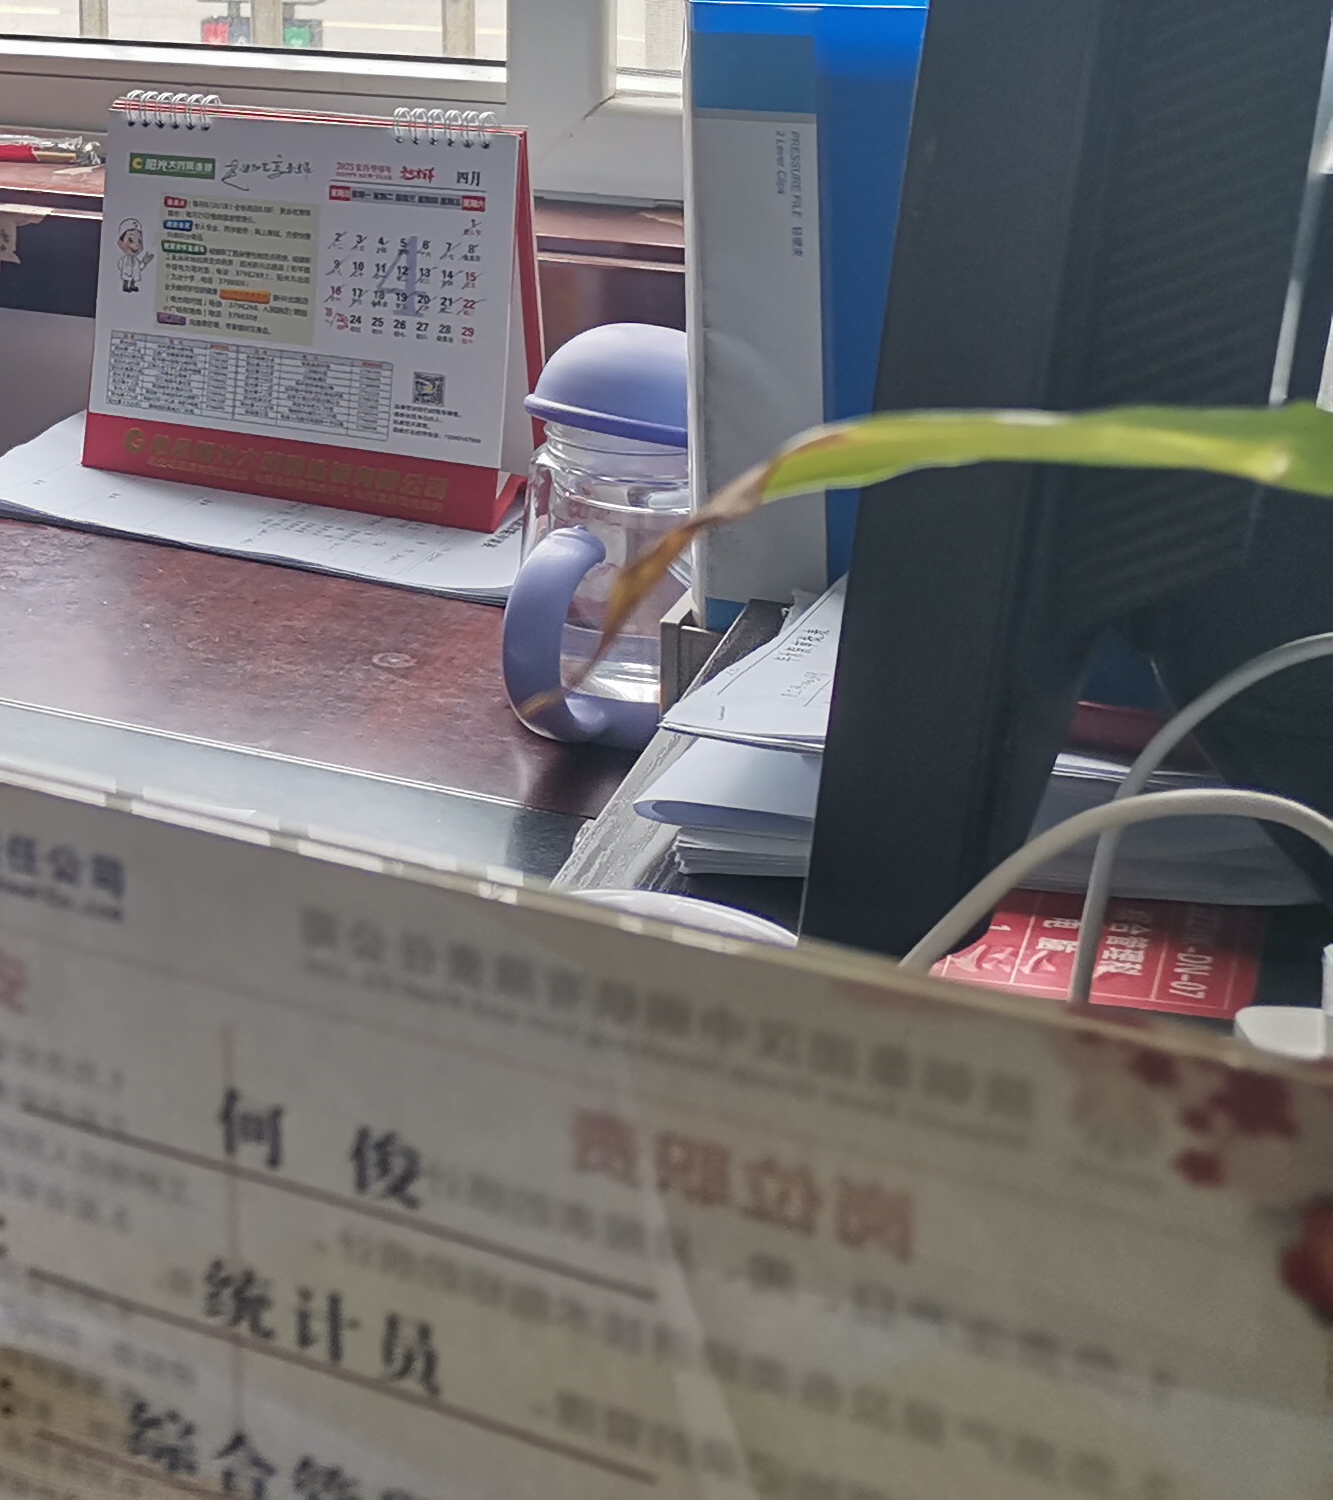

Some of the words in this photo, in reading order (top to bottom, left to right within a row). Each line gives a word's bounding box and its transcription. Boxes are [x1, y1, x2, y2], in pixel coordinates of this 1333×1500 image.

[456, 171, 481, 186] 四月
[349, 315, 362, 325] 24
[371, 317, 384, 327] 25
[393, 319, 407, 329] 26
[415, 322, 429, 332] 27
[438, 324, 451, 334] 28
[461, 327, 475, 337] 29
